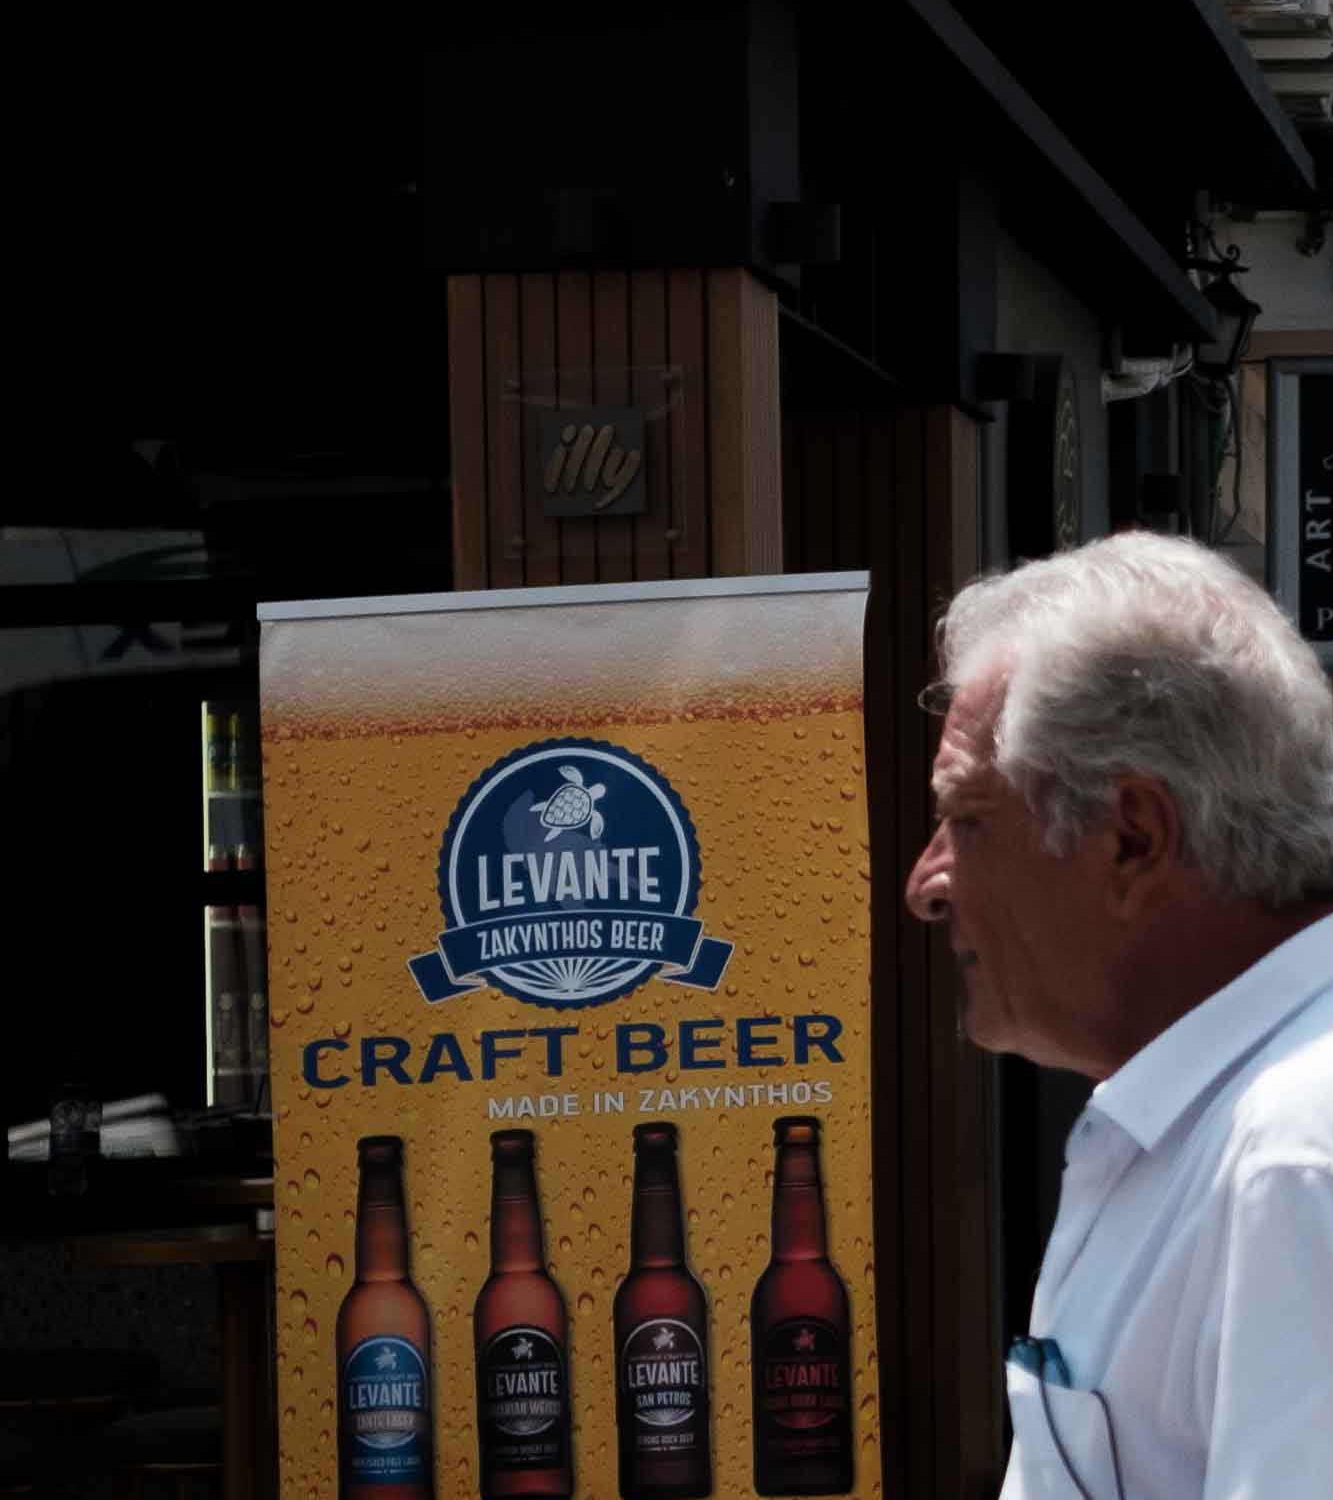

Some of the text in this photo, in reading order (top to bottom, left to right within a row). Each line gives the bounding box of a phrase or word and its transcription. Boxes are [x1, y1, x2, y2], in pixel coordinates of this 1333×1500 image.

[543, 424, 641, 510] illy
[1305, 490, 1333, 573] ART
[478, 846, 661, 911] LEVANTE
[477, 919, 665, 960] ZAKYNTHOS BEER
[303, 1014, 846, 1089] CRAFT BEER
[488, 1081, 833, 1119] MADE IN ZAKYNTHOS
[487, 1370, 560, 1398] LEVANTE
[627, 1361, 700, 1389] LEVANTE
[765, 1362, 841, 1389] LEVANTE
[348, 1380, 422, 1410] LEVANTE
